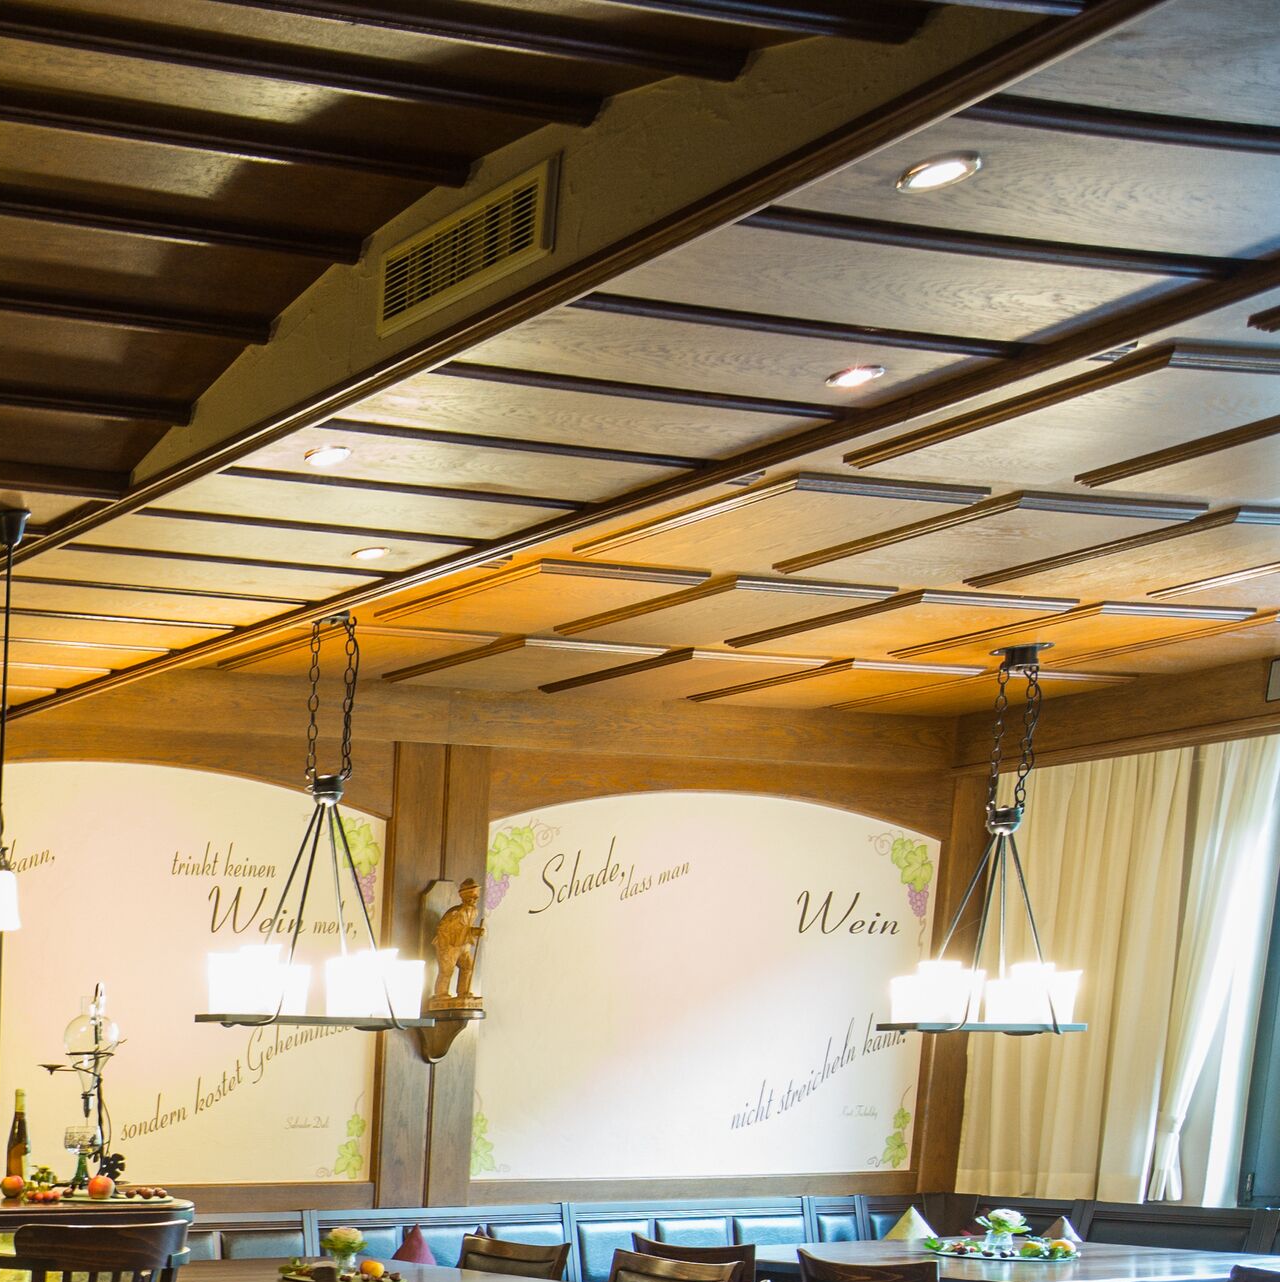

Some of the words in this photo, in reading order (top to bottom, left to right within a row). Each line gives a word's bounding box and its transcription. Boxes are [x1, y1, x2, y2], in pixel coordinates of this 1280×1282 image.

[171, 841, 218, 876] trinkt
[224, 842, 276, 878] keinen
[528, 836, 626, 915] Schade,
[619, 864, 652, 900] dass
[658, 861, 690, 885] man
[208, 885, 306, 934] Wein
[313, 900, 358, 939] mehr,
[796, 890, 900, 935] Wein
[730, 1079, 774, 1130] nicht
[777, 1017, 856, 1114] streicheln
[862, 1013, 906, 1056] kann.
[120, 1093, 188, 1141] sondern
[194, 1059, 243, 1116] kostet
